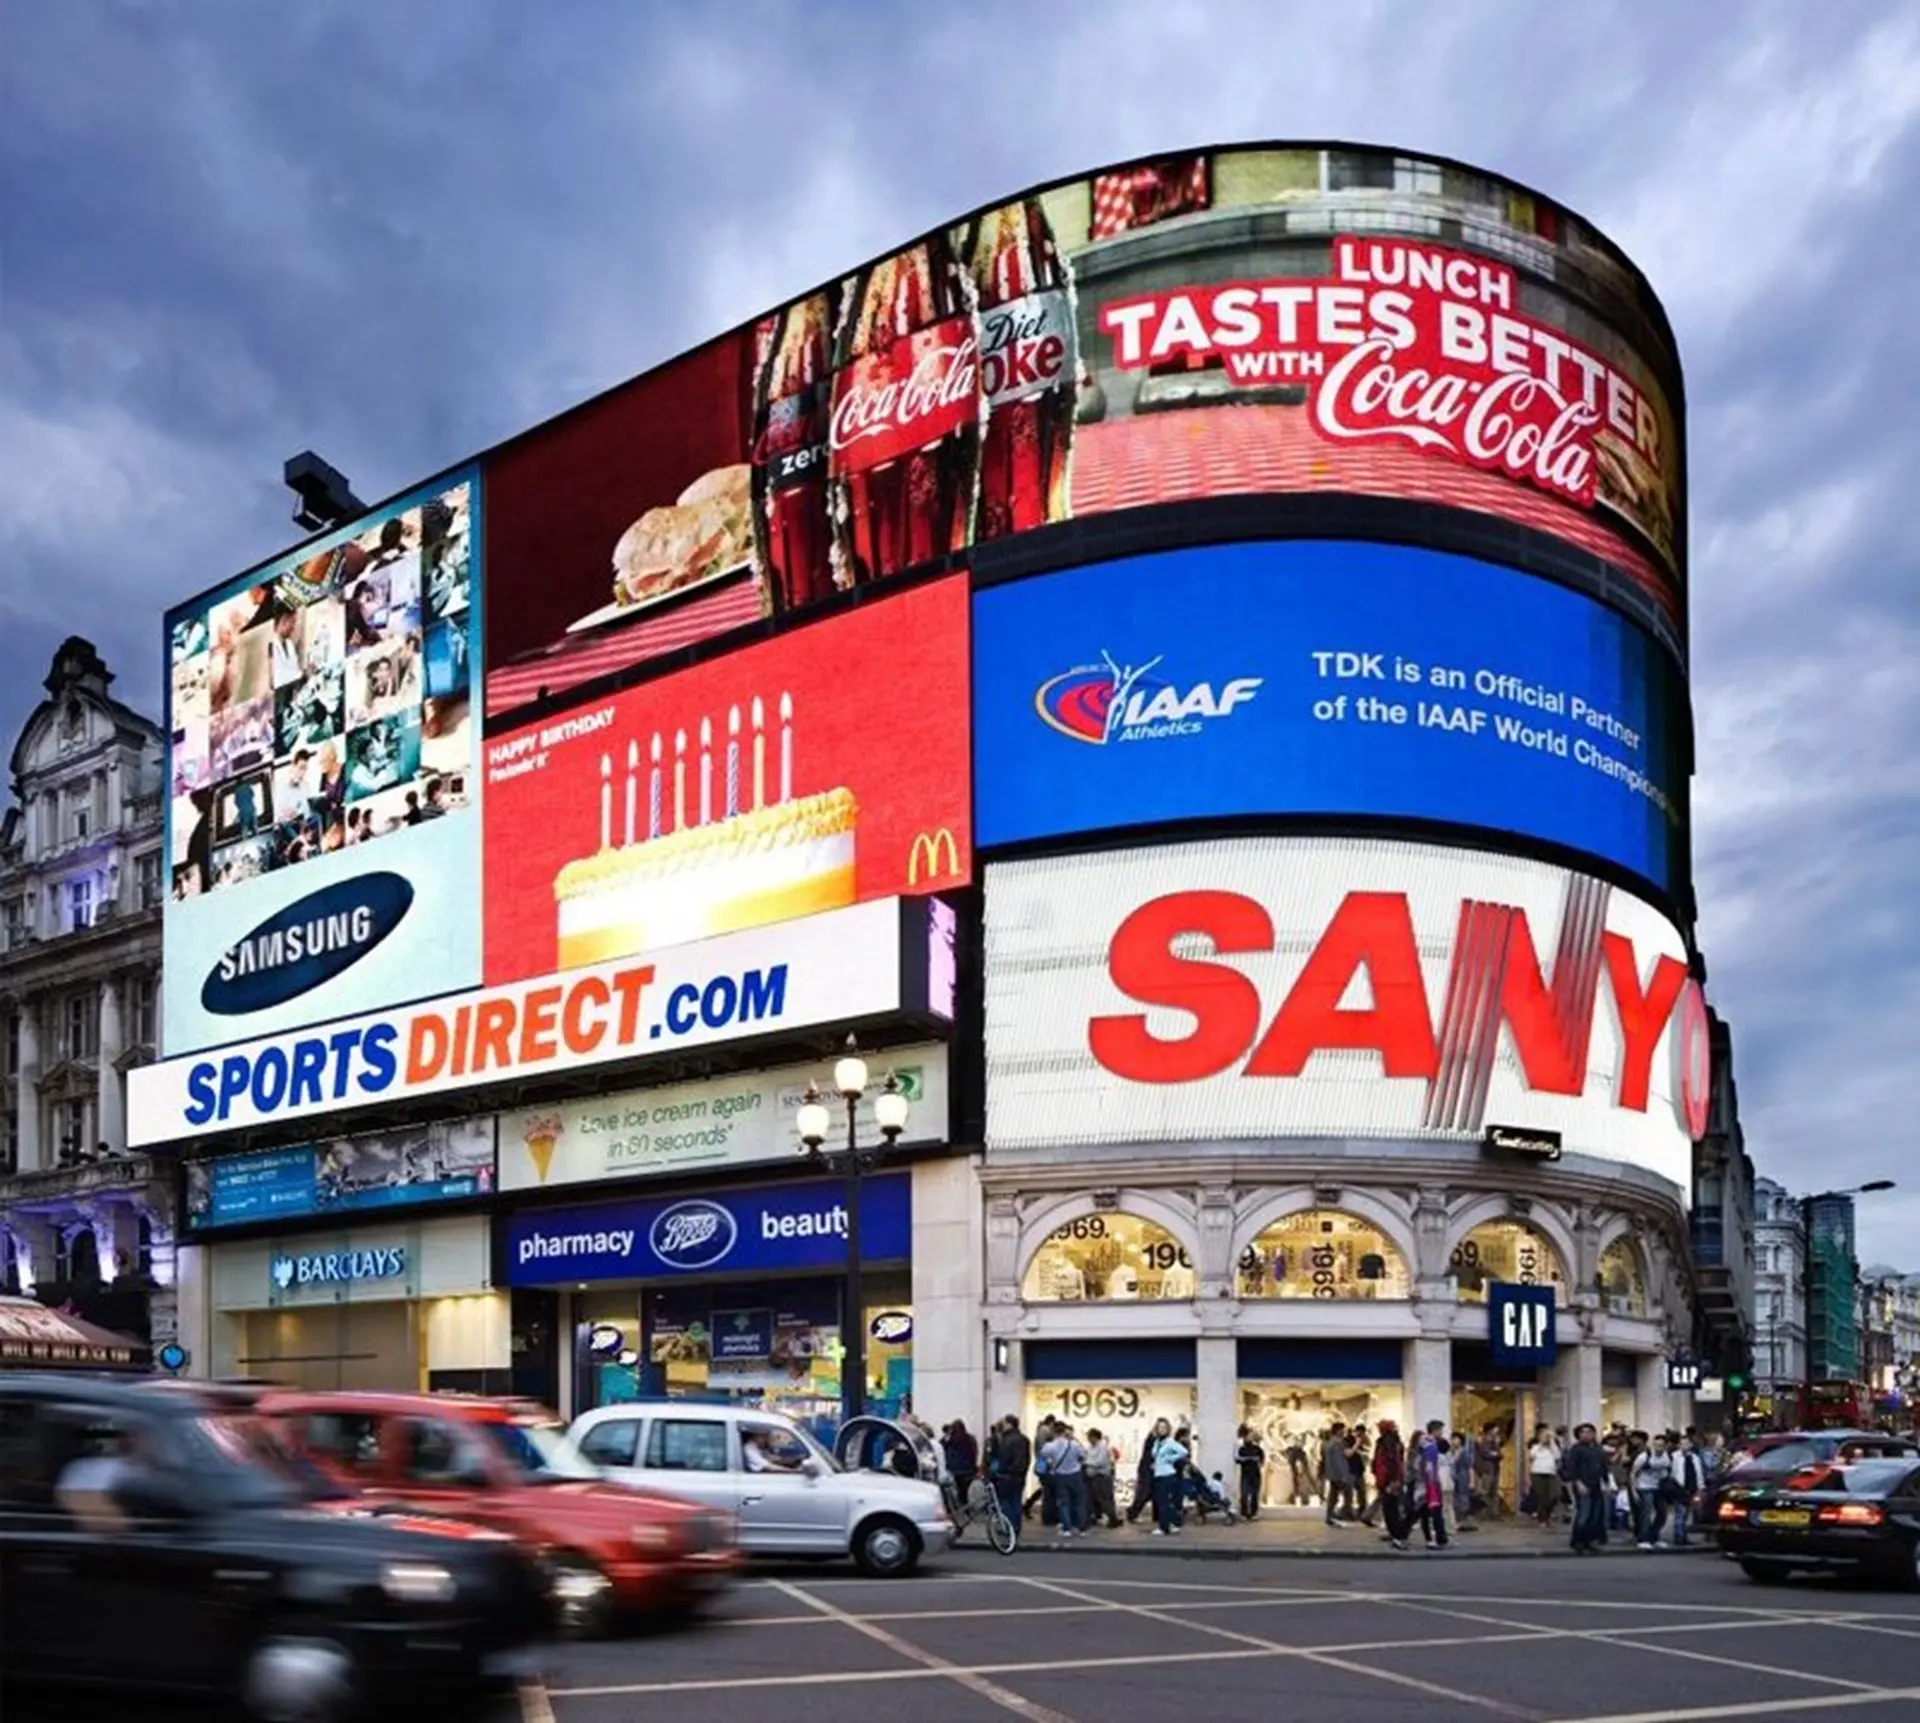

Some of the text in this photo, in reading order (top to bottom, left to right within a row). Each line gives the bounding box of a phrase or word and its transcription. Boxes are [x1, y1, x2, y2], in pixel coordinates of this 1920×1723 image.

[1339, 244, 1511, 310] LUNCH
[984, 308, 1048, 354] Diet
[829, 338, 978, 450] Coca-Cola
[981, 335, 1064, 396] oke
[1106, 288, 1661, 470] TASTES BETTER
[1231, 338, 1602, 492] WITH Coca-Cola
[1118, 720, 1202, 742] Athletics
[1123, 678, 1263, 725] IAAF
[1313, 652, 1641, 750] TDK is an Official Partner
[1313, 696, 1346, 720] of
[1356, 697, 1407, 723] the
[1417, 708, 1486, 736] IAAF
[1494, 715, 1568, 758] World
[488, 706, 616, 766] HAPPY BIRTHDAY
[219, 906, 375, 982] SAMSUNG
[1088, 872, 1710, 1141] SANYO
[185, 964, 788, 1127] SPORTSDIRECT.COM
[623, 1106, 648, 1127] ice
[652, 1100, 708, 1124] cream
[712, 1092, 762, 1118] again
[298, 1249, 403, 1284] BARCLAYS
[519, 1228, 635, 1264] pharmacy
[660, 1212, 718, 1253] Boots
[1503, 1302, 1548, 1348] GAP
[1056, 1388, 1145, 1418] 1969.
[1672, 1366, 1698, 1385] GAP
